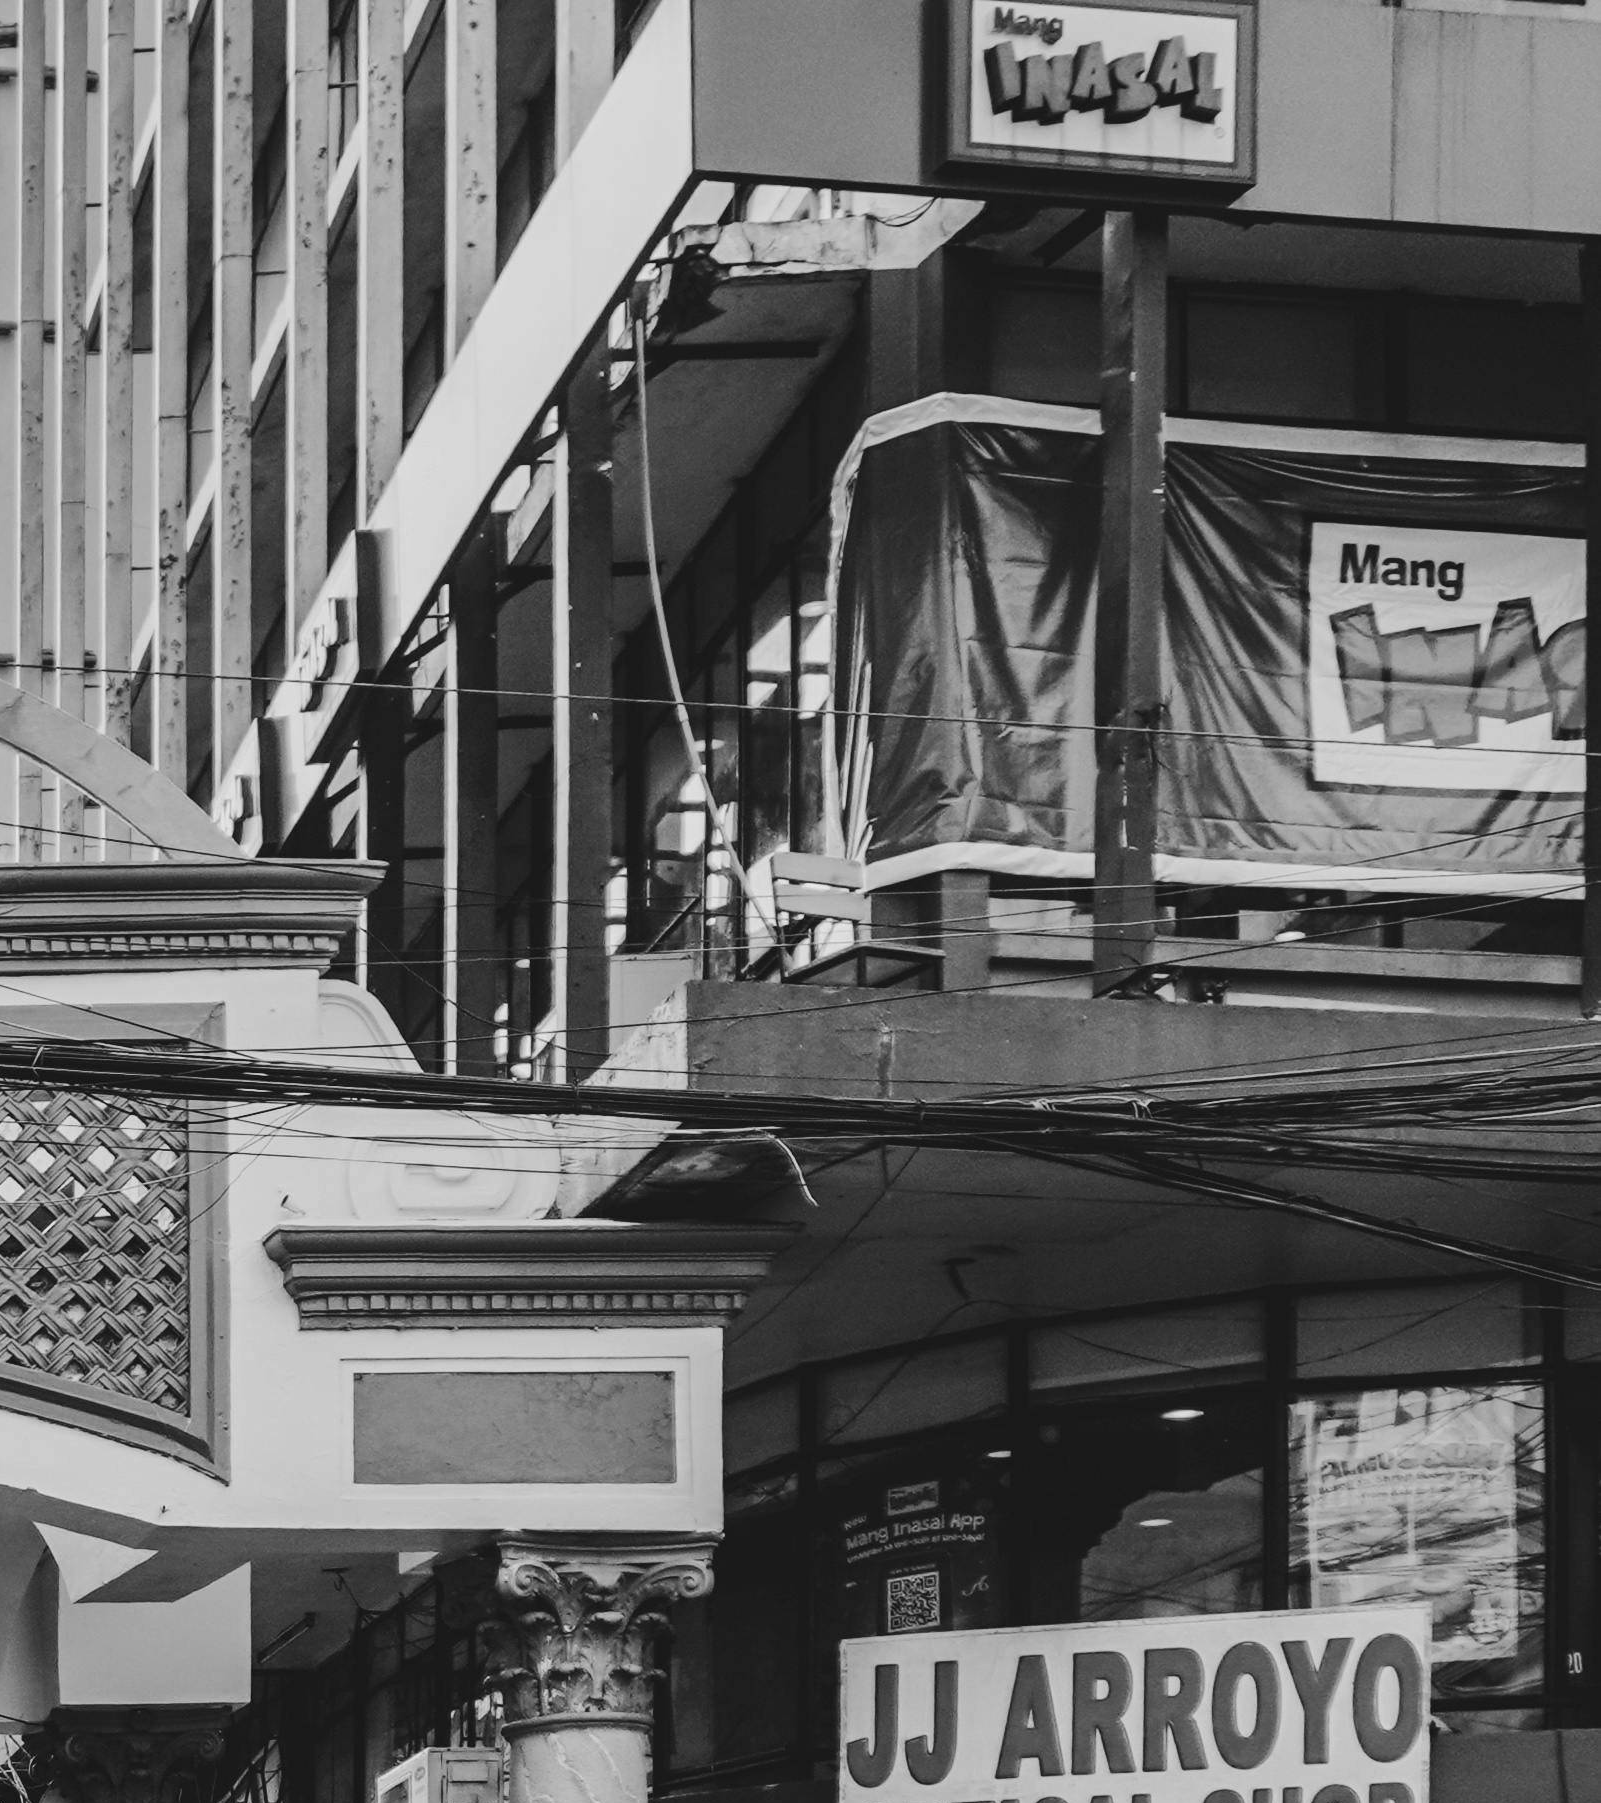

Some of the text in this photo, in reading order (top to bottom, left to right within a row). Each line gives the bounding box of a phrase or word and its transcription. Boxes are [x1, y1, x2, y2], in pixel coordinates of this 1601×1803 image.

[993, 7, 1063, 45] Mang
[984, 35, 1223, 125] INASAL
[1339, 543, 1465, 601] Mang
[846, 1513, 986, 1551] Mang Inasal App
[846, 1632, 1424, 1788] JJ ARROYO
